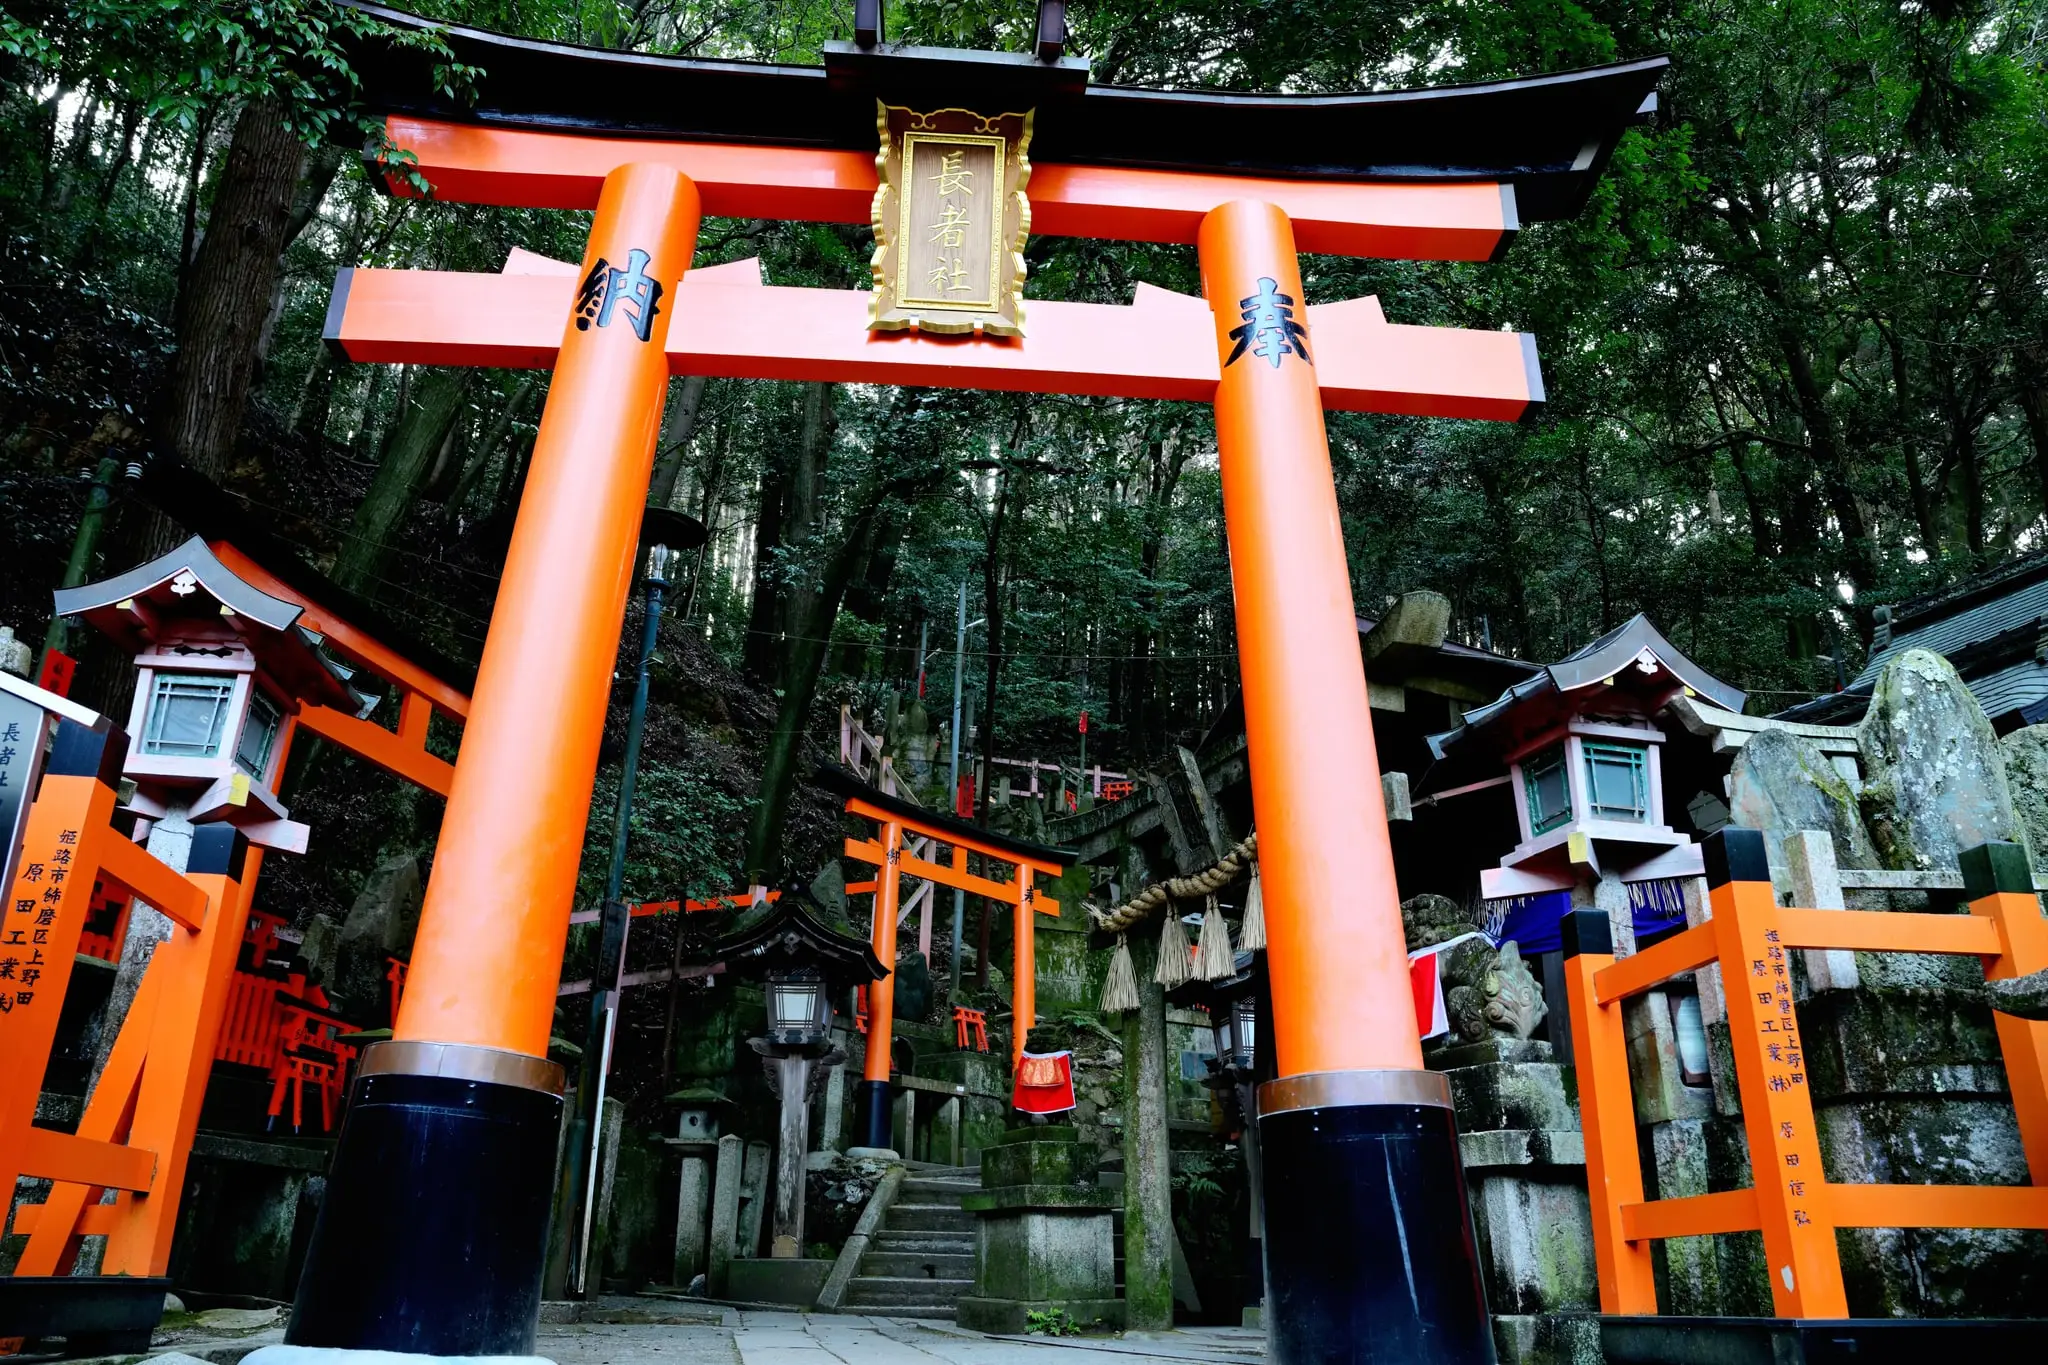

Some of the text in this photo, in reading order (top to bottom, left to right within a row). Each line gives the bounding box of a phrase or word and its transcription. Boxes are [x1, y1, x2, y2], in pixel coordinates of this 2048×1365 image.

[928, 150, 975, 294] 長者社
[575, 248, 663, 342] 納
[1223, 276, 1313, 369] 奉
